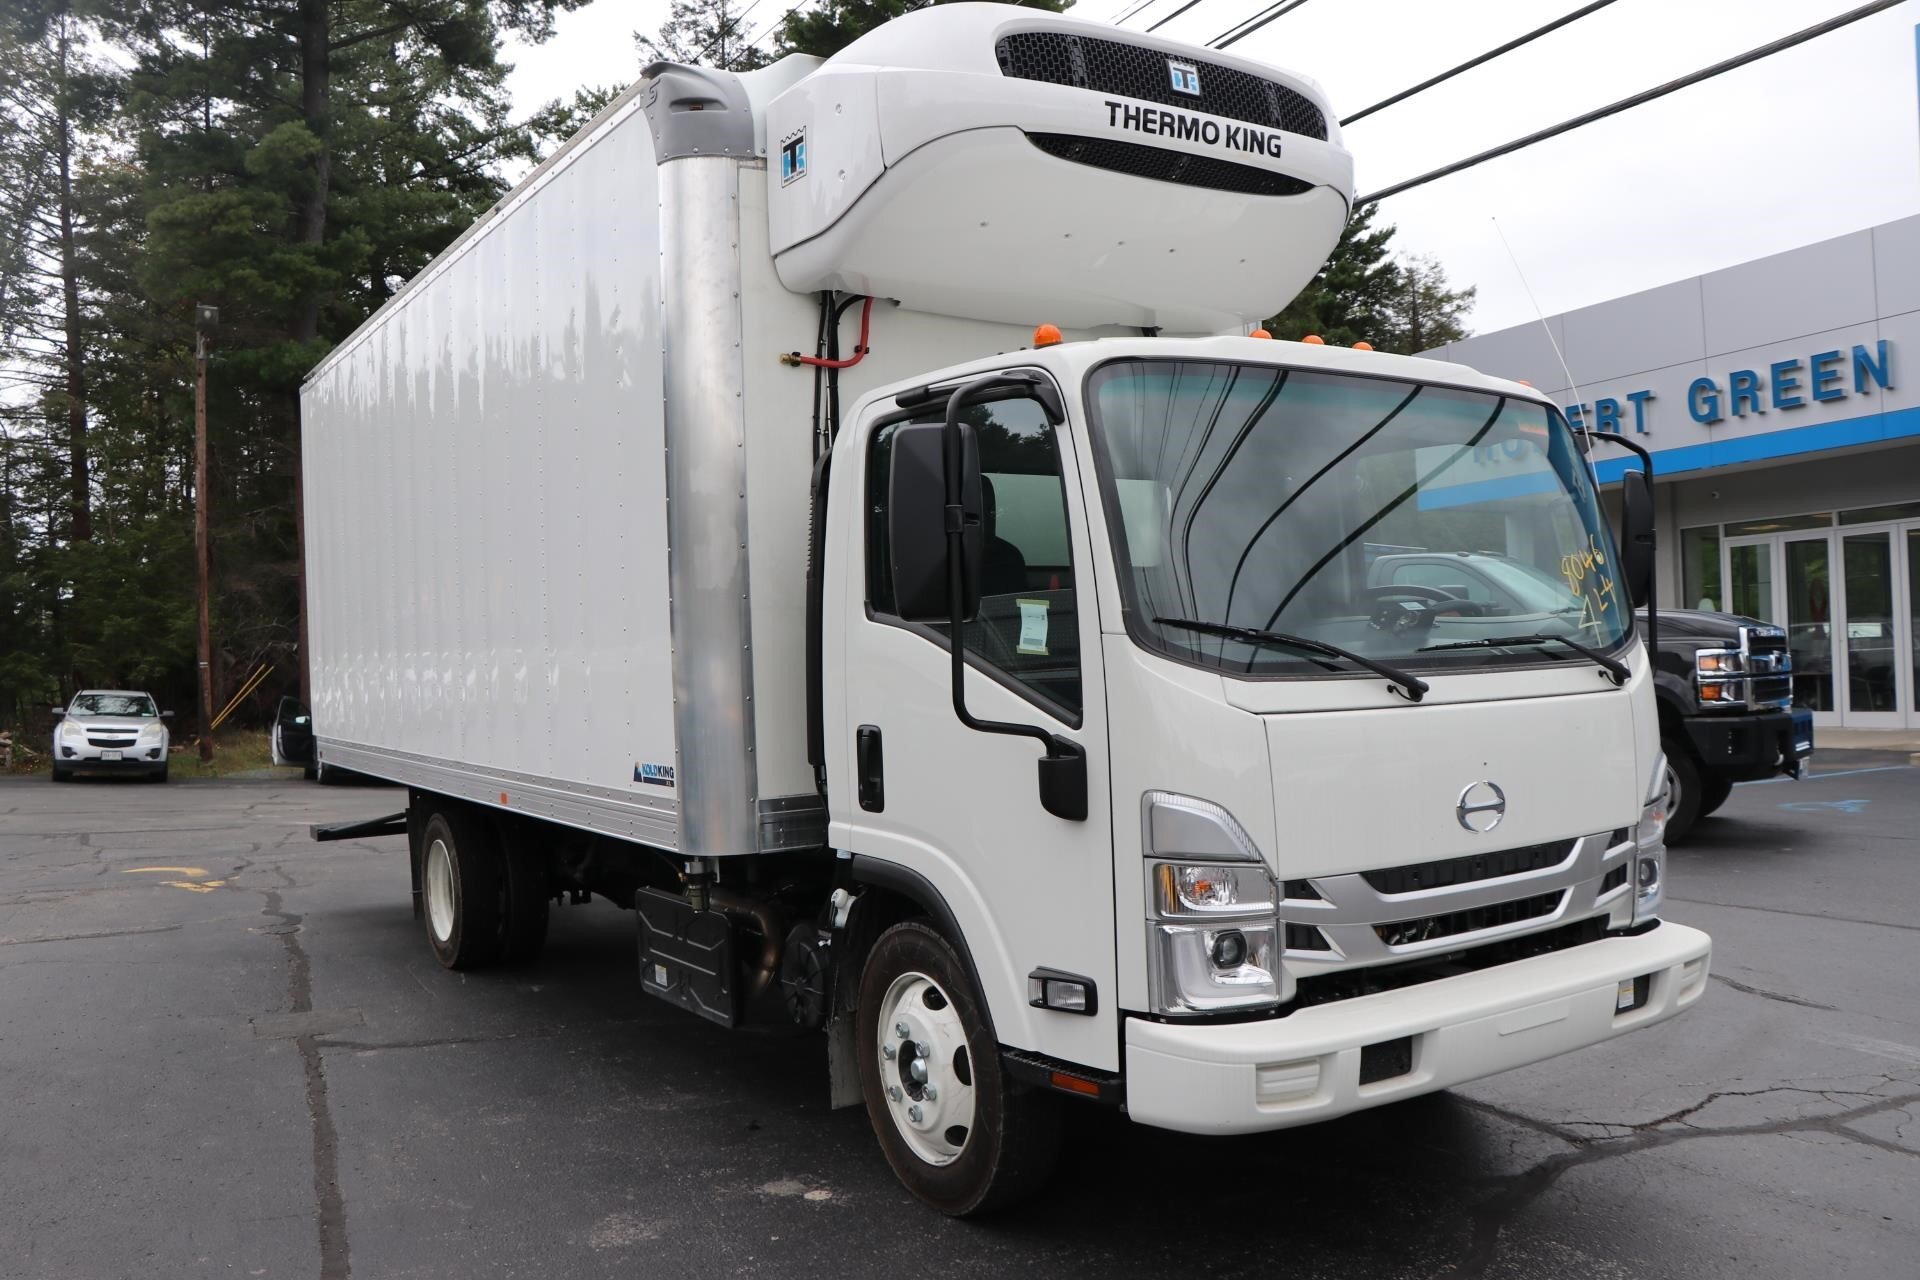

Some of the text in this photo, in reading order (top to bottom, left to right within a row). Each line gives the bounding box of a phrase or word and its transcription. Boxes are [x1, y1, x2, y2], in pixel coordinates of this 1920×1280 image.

[1105, 101, 1281, 159] THERMO KING
[1687, 339, 1890, 424] GREEN
